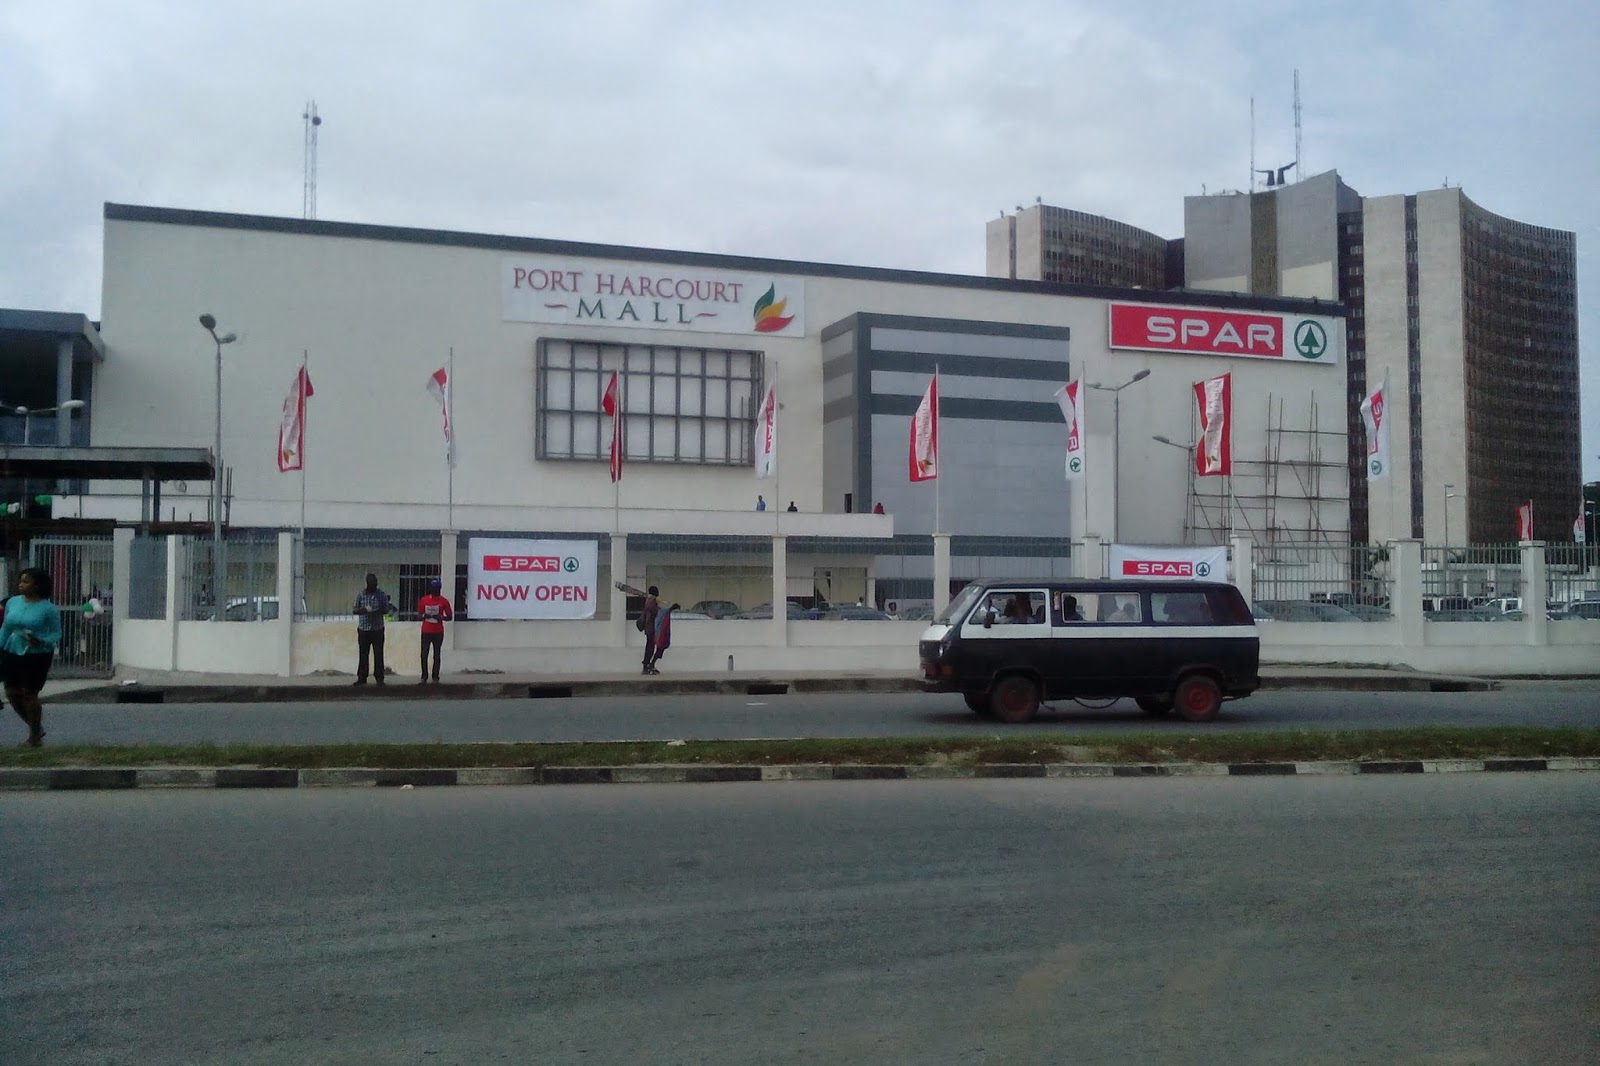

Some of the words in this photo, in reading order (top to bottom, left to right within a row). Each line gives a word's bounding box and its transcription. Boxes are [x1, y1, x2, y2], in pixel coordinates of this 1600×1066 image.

[513, 267, 583, 293] PORT
[596, 273, 743, 303] HARCOURT
[575, 298, 692, 324] MALL
[1146, 316, 1276, 350] SPAR
[499, 558, 559, 569] SPAR
[1137, 563, 1192, 574] SPAR
[477, 584, 530, 601] NOW
[535, 585, 588, 602] OPEN
